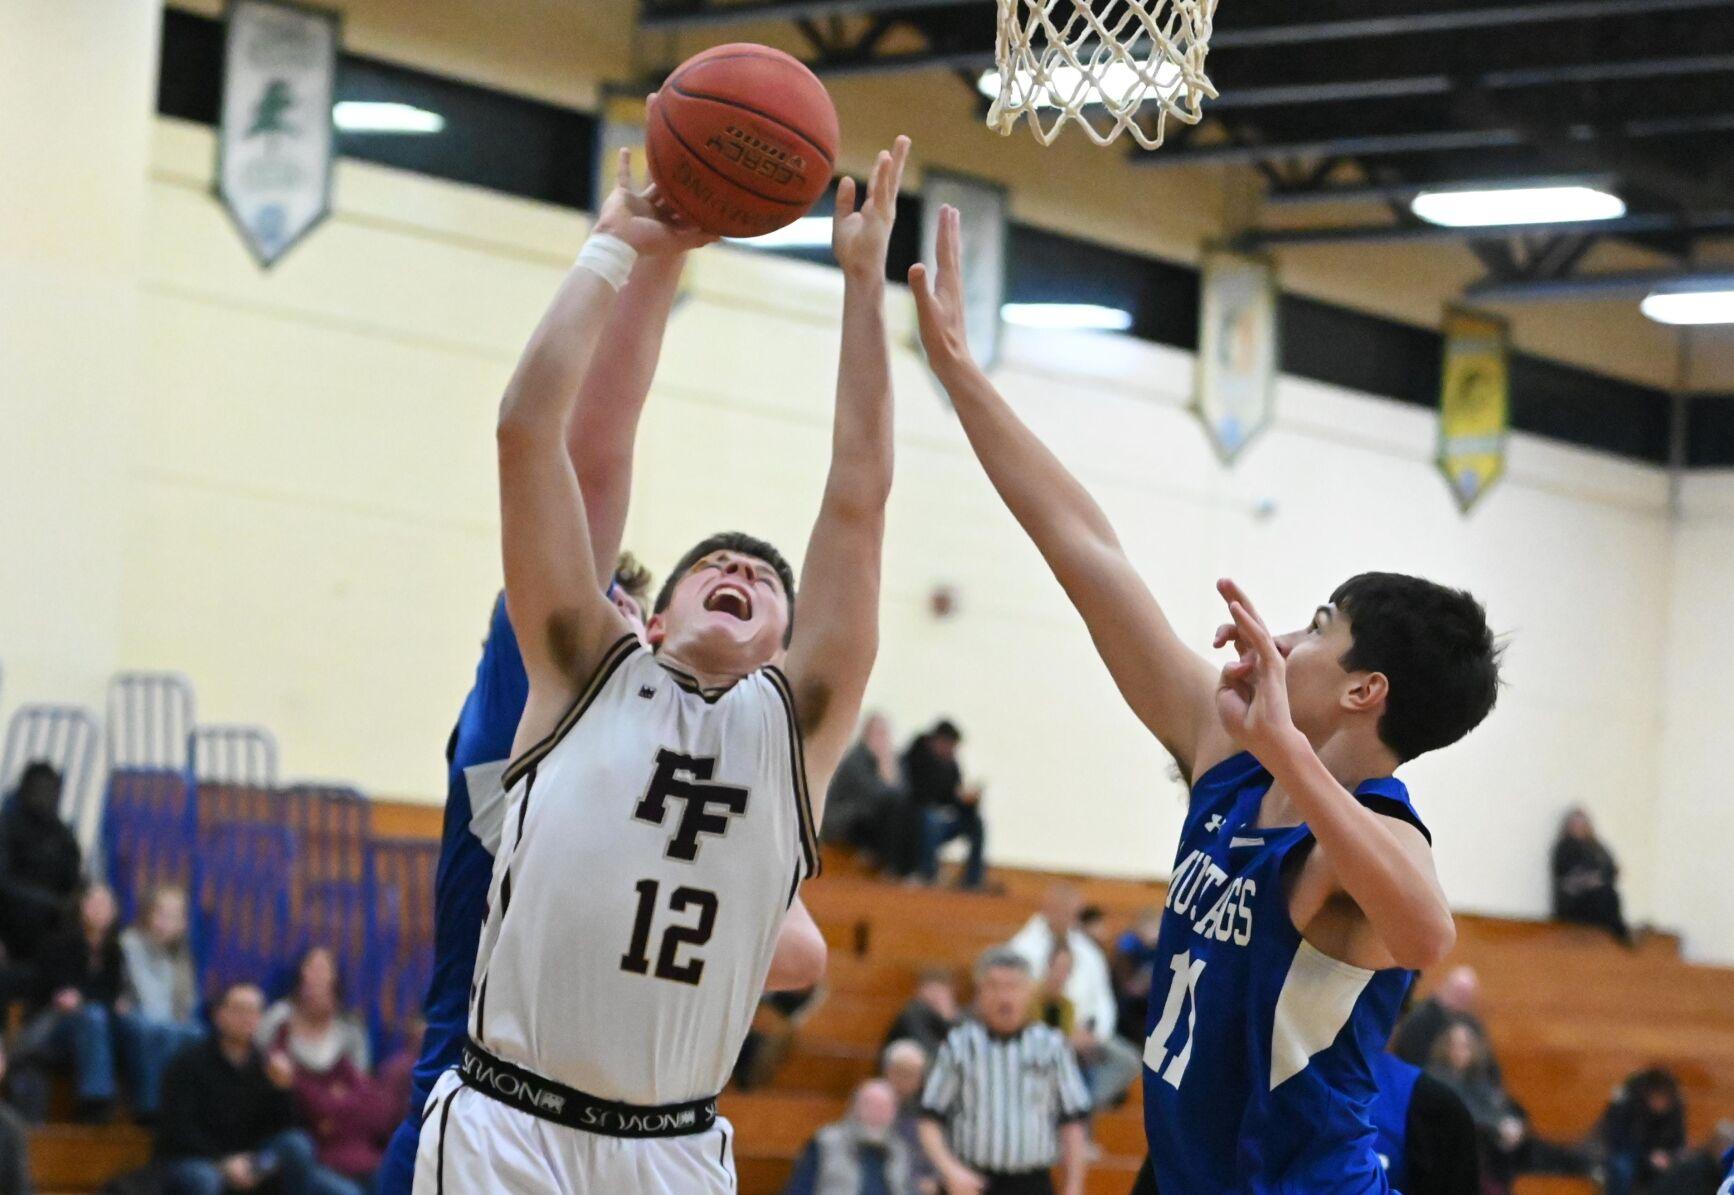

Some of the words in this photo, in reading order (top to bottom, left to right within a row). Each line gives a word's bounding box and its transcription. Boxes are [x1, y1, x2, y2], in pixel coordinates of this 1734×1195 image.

[704, 133, 806, 185] LEGACY
[631, 745, 751, 864] FF
[620, 879, 719, 986] 12
[1166, 848, 1256, 947] MUTAGS
[1143, 949, 1207, 1091] 11
[462, 1047, 542, 1107] NOVUS
